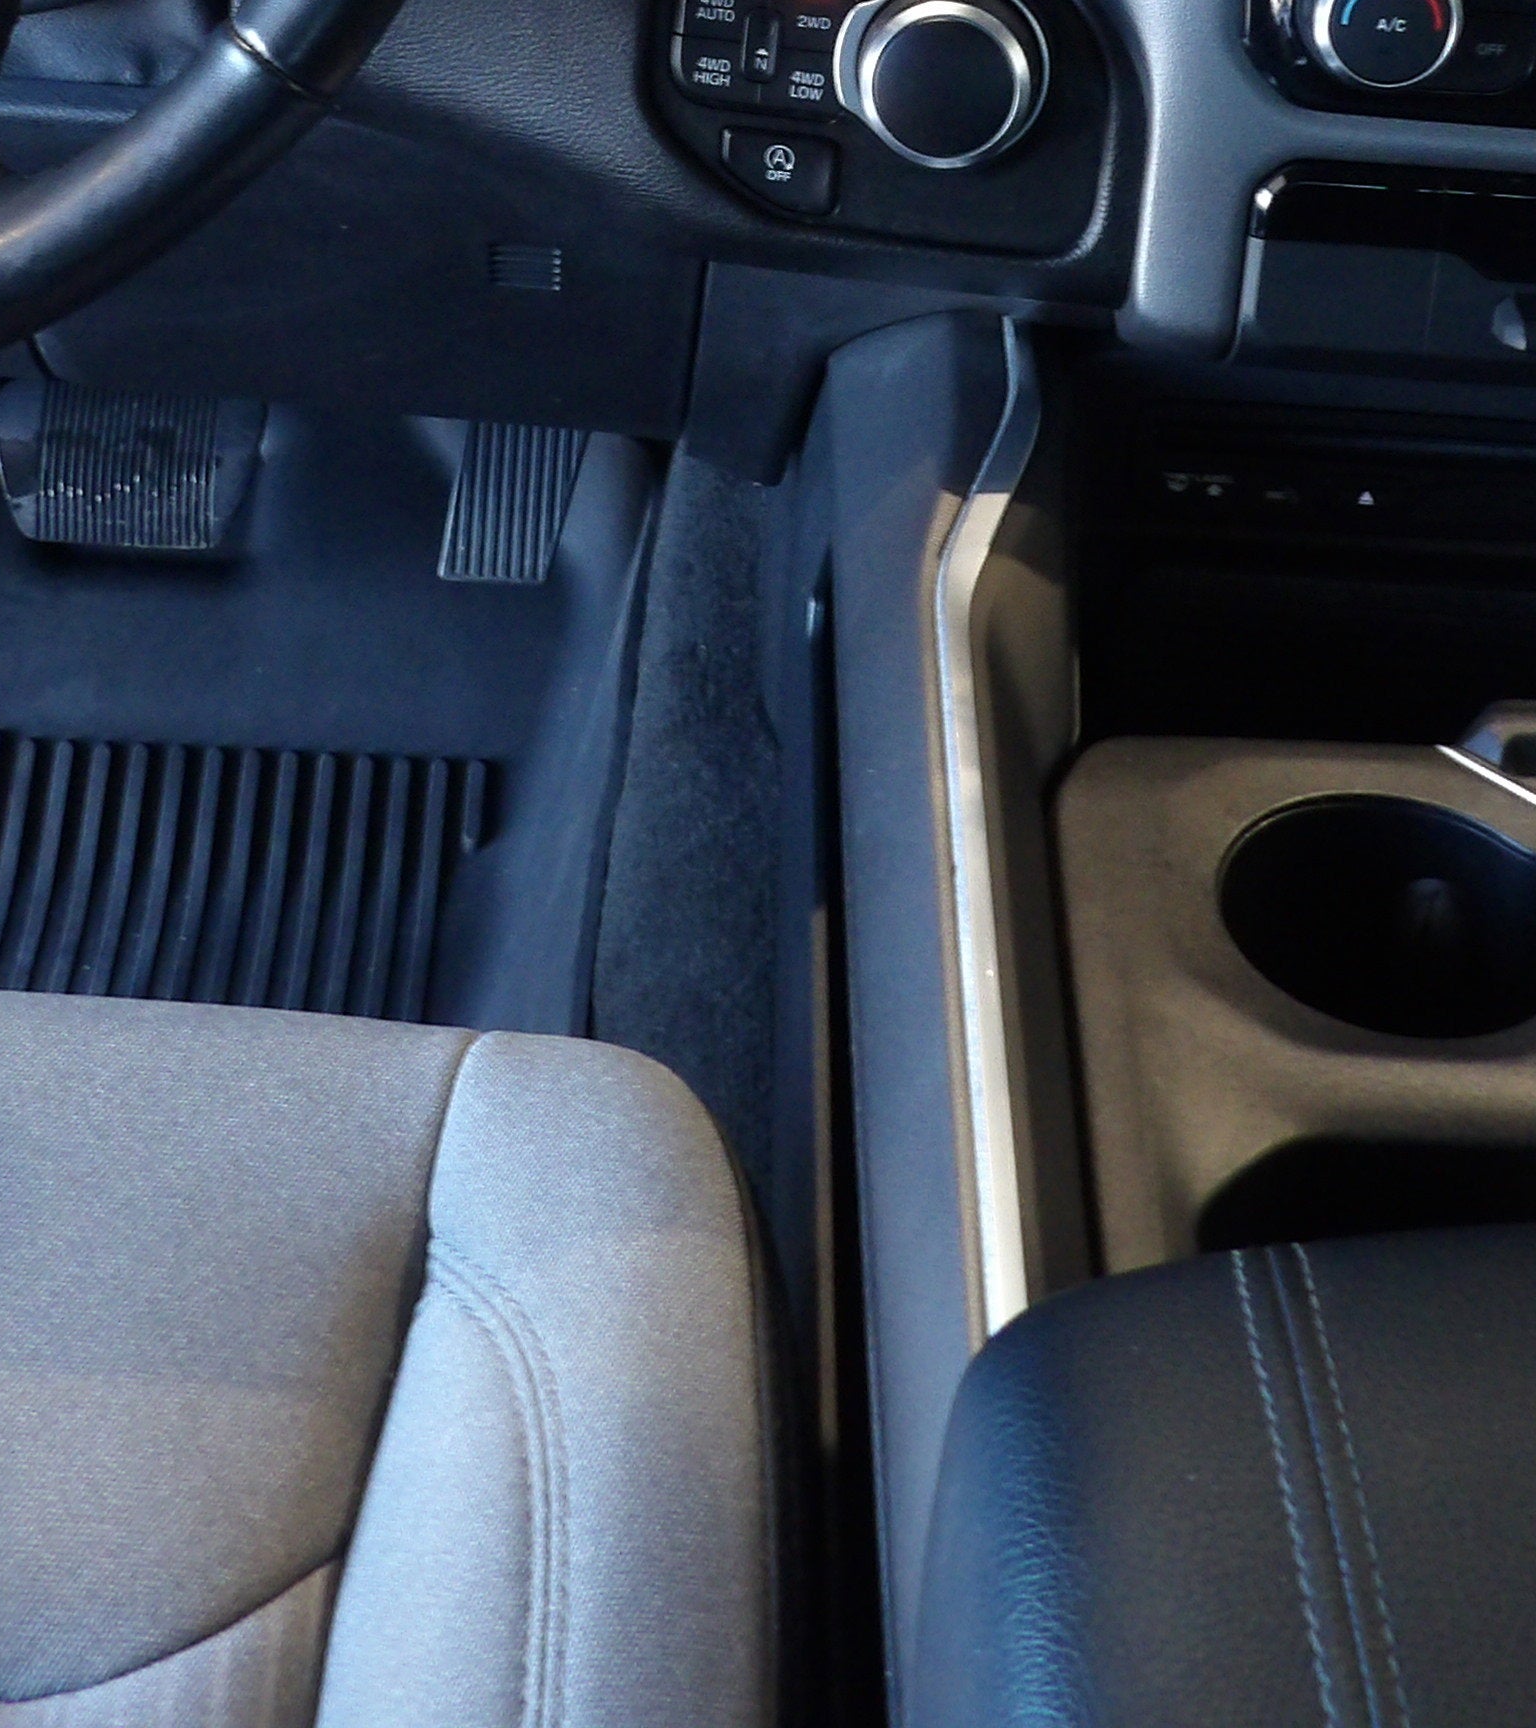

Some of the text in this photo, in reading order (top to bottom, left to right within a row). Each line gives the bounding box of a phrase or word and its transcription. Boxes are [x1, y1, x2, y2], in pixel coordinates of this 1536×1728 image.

[696, 5, 736, 23] AUTO
[796, 14, 832, 31] 2WD
[1376, 18, 1407, 33] A/C
[1475, 43, 1506, 56] OFF
[696, 56, 732, 74] 4WD
[754, 57, 768, 71] N
[693, 70, 731, 88] HIGH
[789, 71, 825, 87] 4WD
[789, 85, 824, 101] LOW
[766, 170, 792, 182] OFF
